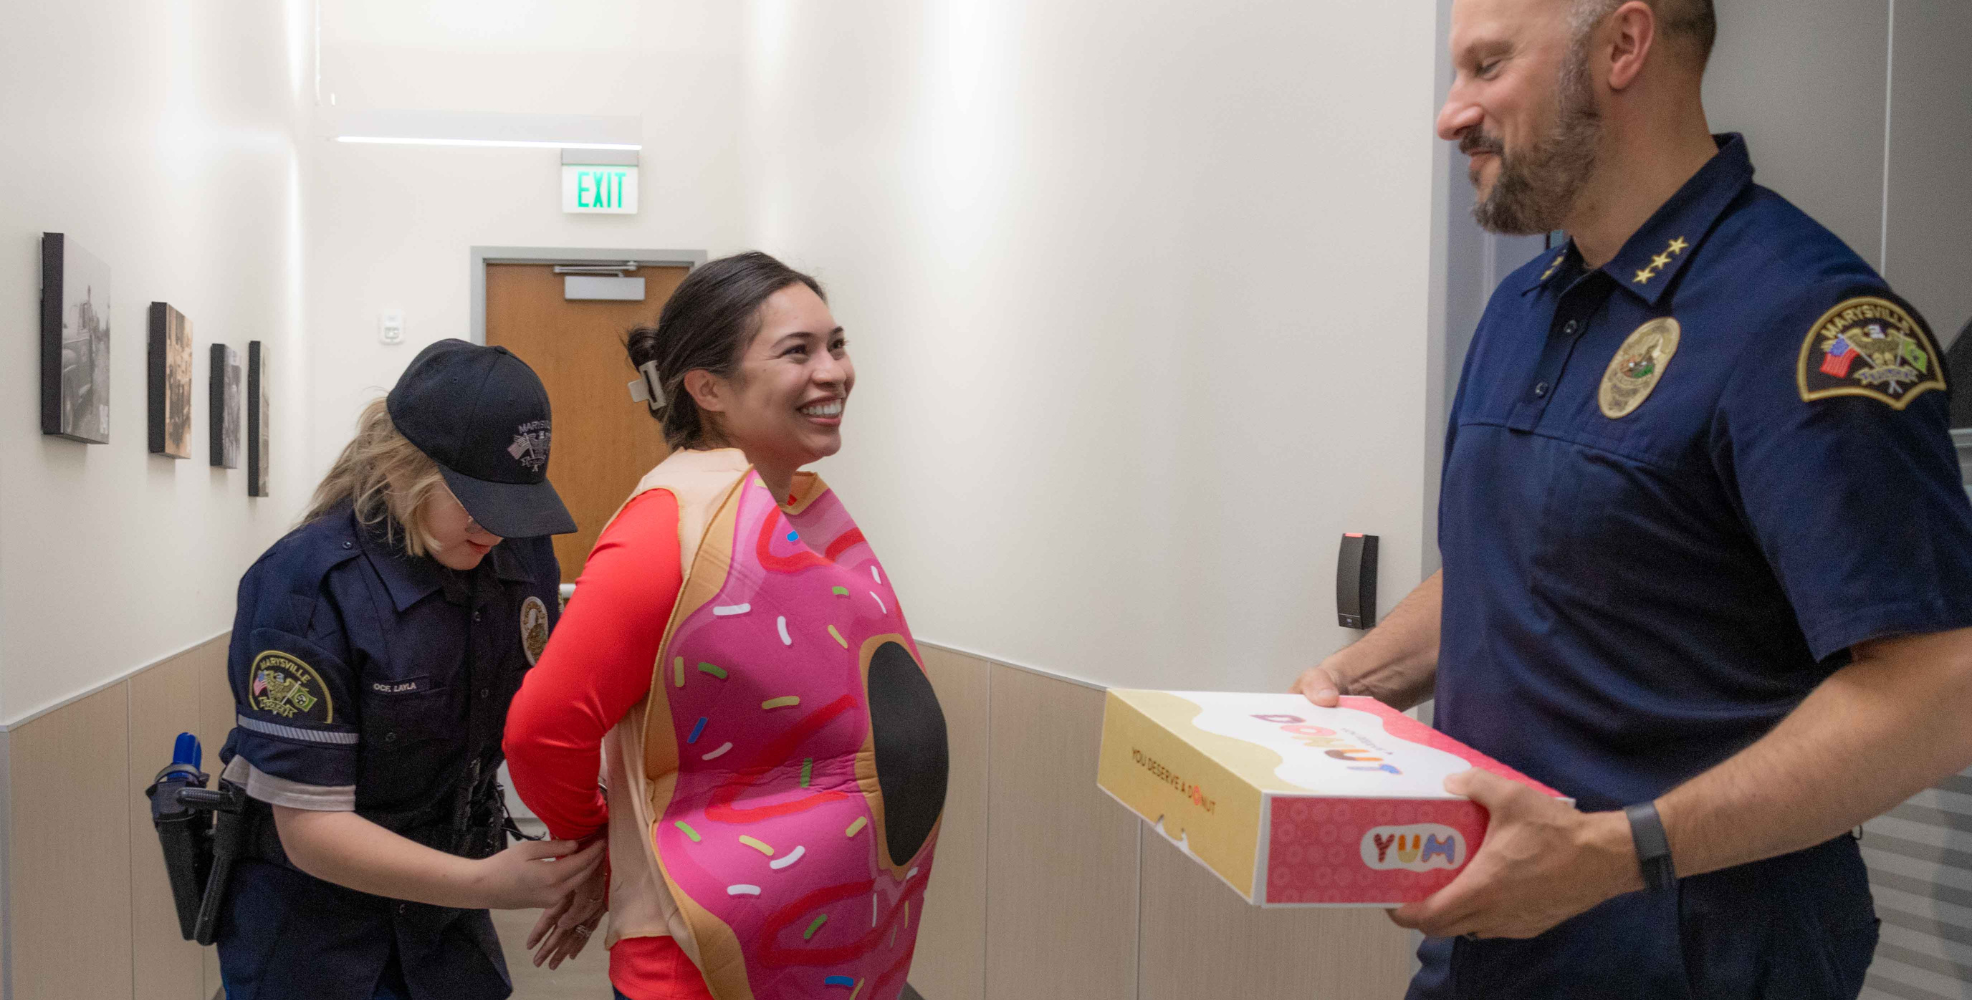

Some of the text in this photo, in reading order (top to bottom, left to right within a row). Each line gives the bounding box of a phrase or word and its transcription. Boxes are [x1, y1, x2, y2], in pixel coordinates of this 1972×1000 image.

[577, 170, 627, 208] EXIT
[1819, 304, 1912, 340] MARYSVILLE
[259, 657, 312, 684] MARYSVILLE
[1249, 714, 1404, 776] DONUT
[1131, 747, 1217, 816] YOU DESERVE A DONUT
[1373, 832, 1456, 866] YUM
